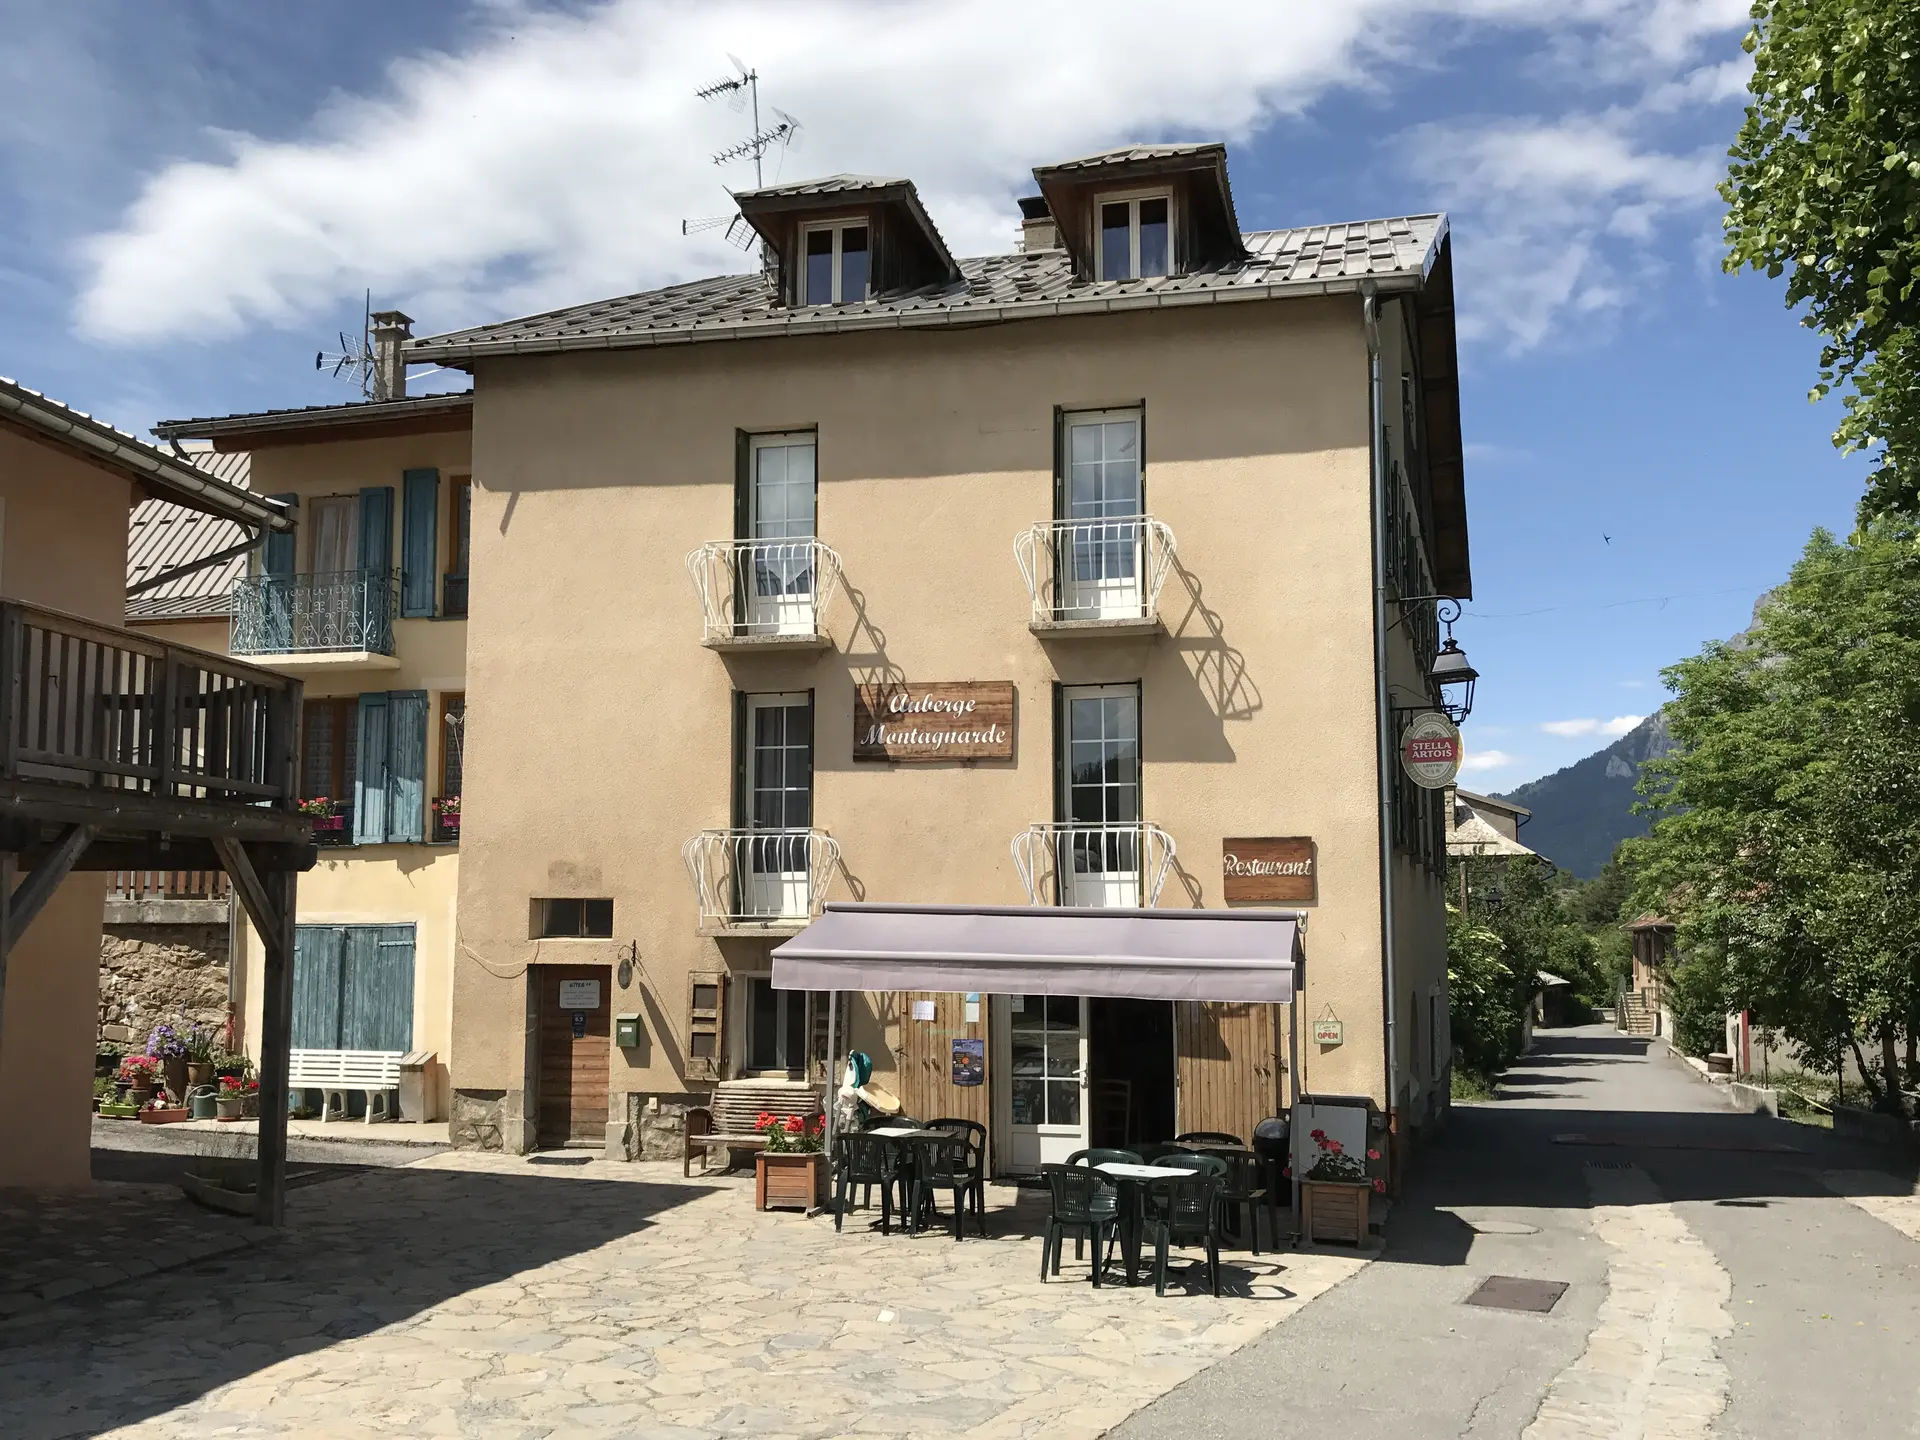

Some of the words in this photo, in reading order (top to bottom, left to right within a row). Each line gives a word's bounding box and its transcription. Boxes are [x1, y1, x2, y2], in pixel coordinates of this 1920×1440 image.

[890, 693, 976, 719] Auberge
[860, 723, 1007, 750] Montagnarde
[1412, 742, 1451, 751] STELLA
[1412, 750, 1452, 758] ARTOIS
[1223, 853, 1312, 877] Restaurant
